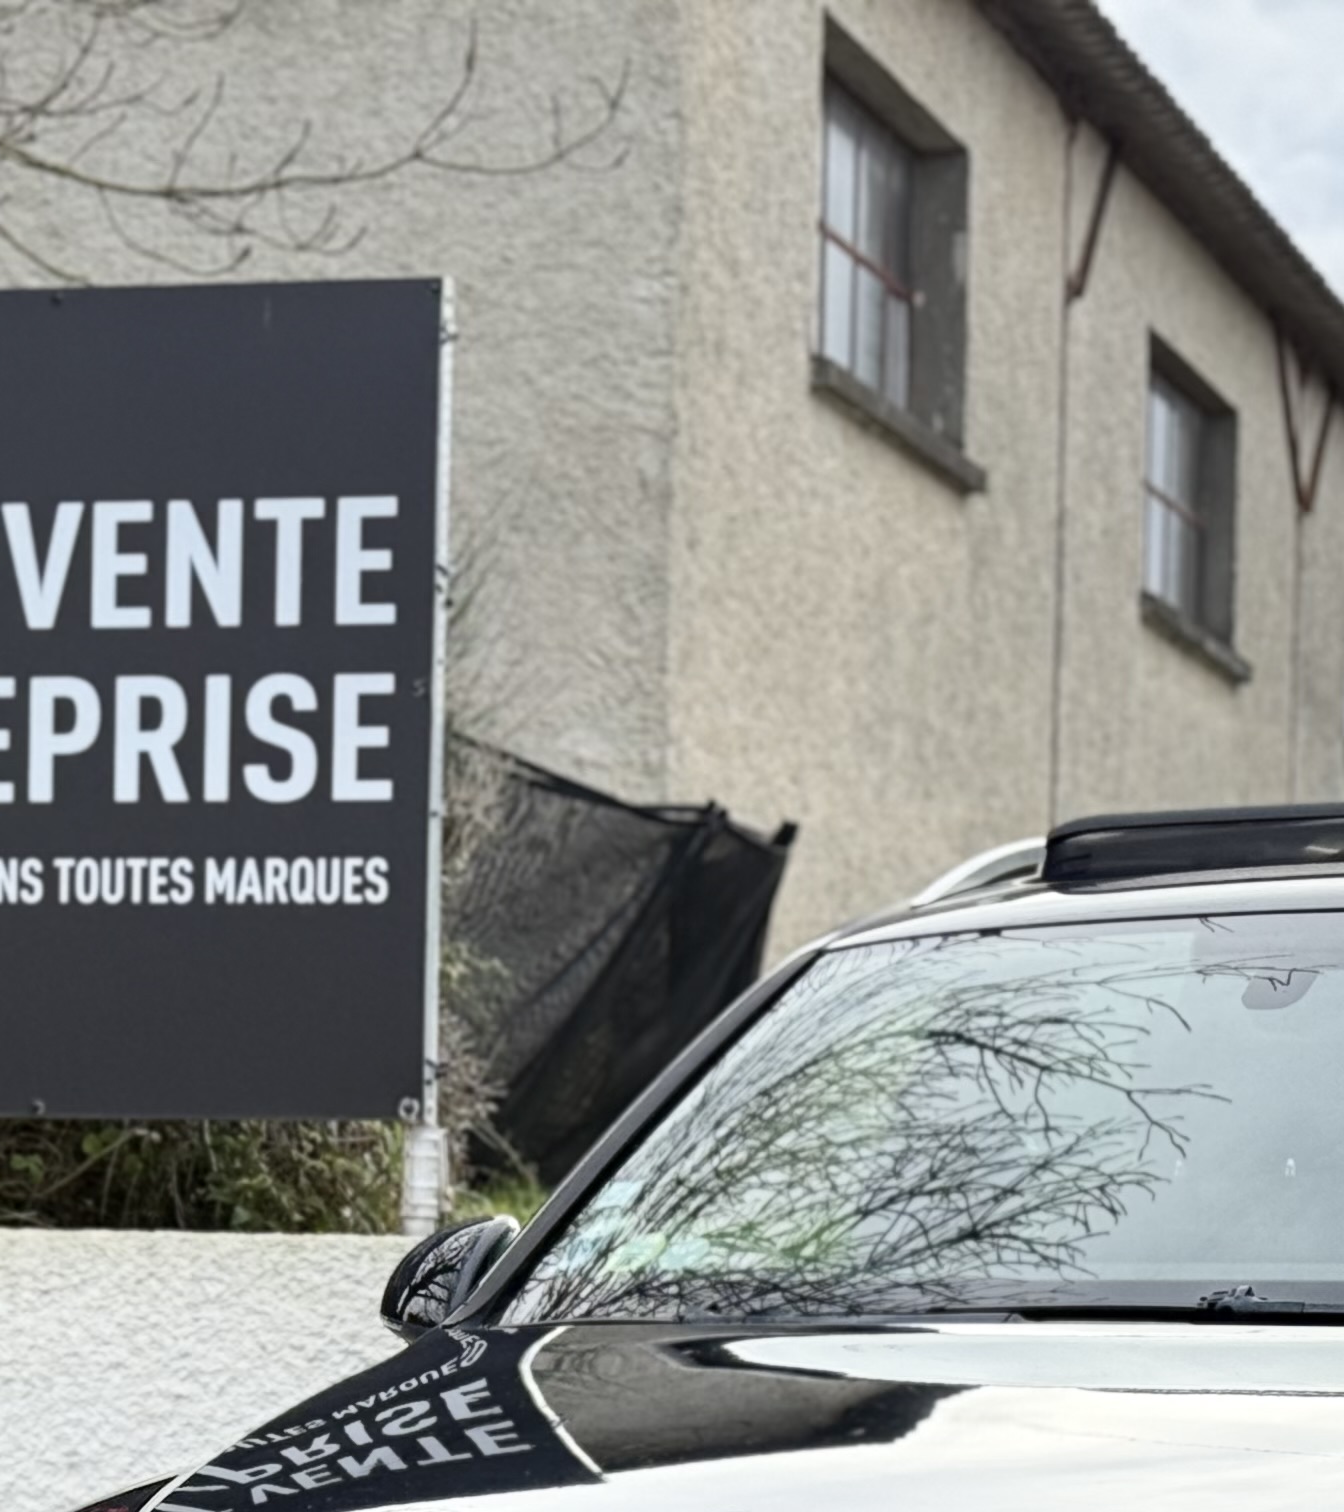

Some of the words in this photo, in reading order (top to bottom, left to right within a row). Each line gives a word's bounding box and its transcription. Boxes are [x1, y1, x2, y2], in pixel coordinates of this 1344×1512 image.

[2, 496, 399, 630] VENTE
[52, 856, 195, 905] TOUTES
[204, 856, 390, 905] MARQUES
